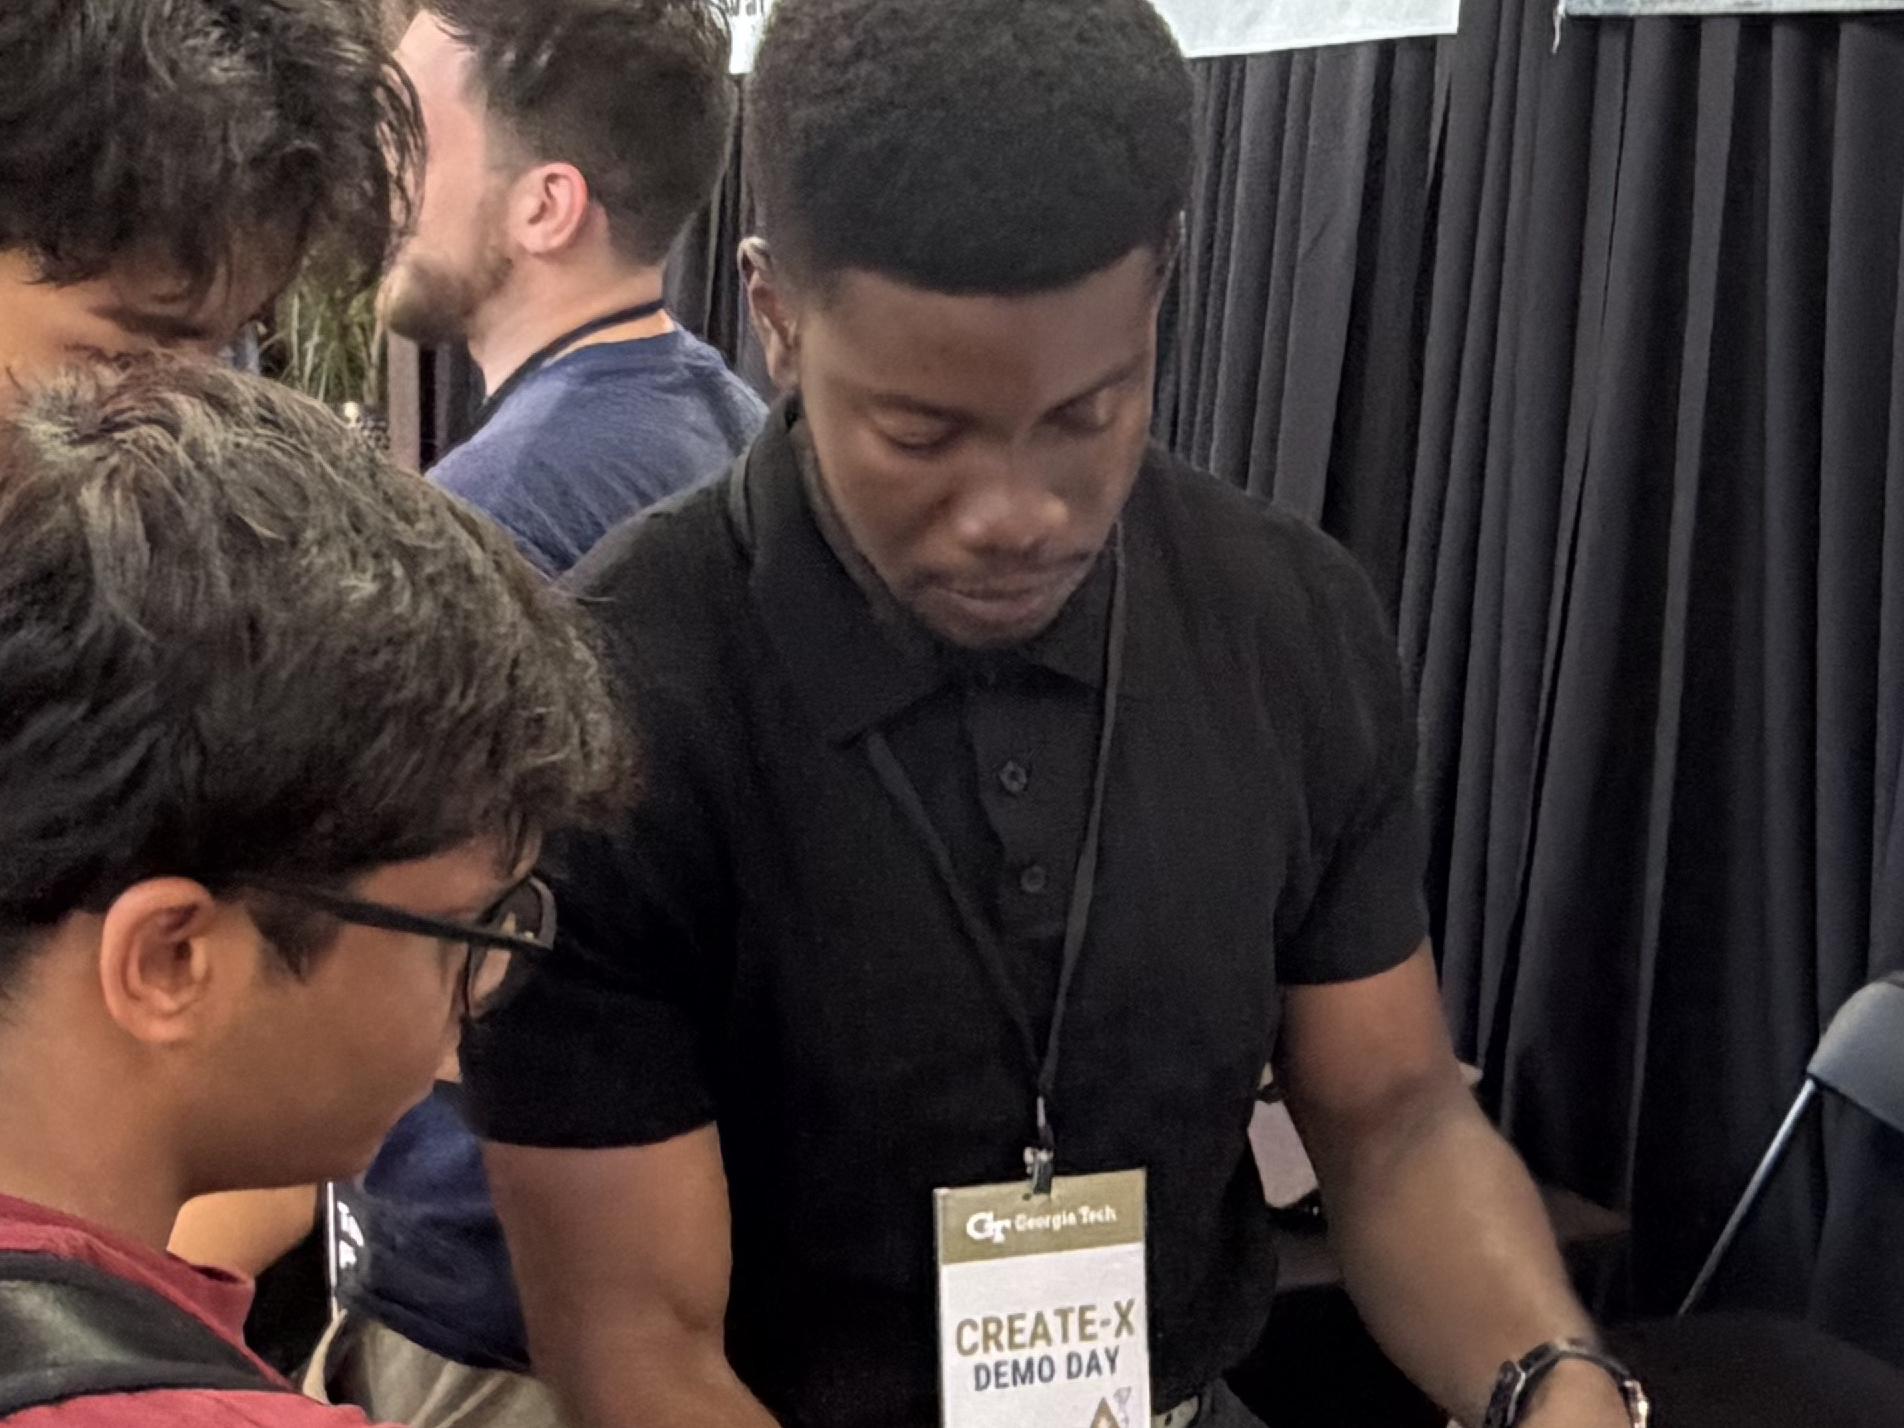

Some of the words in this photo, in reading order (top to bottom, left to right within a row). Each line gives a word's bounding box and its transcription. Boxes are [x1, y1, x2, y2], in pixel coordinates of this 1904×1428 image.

[1014, 1212, 1077, 1232] Georgia
[1079, 1205, 1117, 1225] Tech
[956, 1298, 1135, 1357] CREATE-X
[973, 1353, 1056, 1392] DEMO
[1066, 1345, 1121, 1381] DAY
